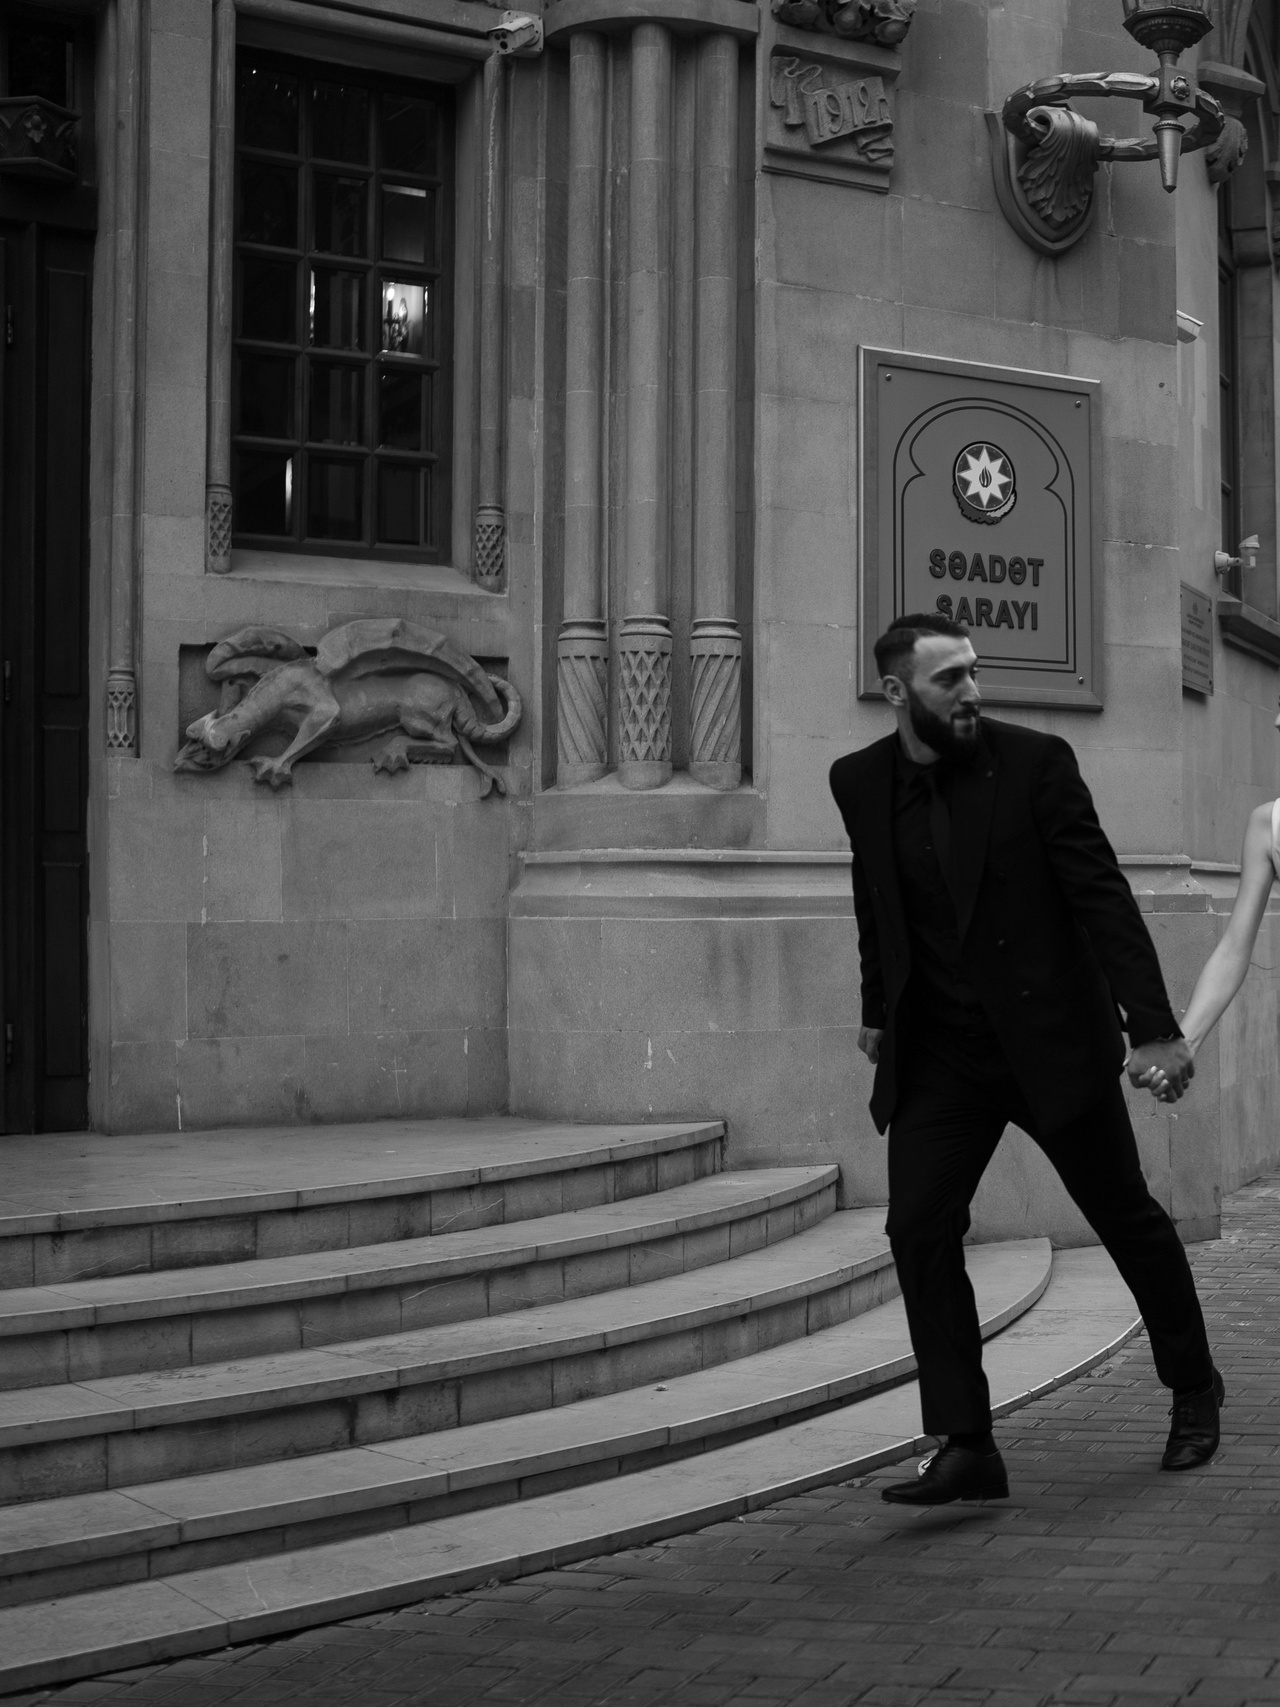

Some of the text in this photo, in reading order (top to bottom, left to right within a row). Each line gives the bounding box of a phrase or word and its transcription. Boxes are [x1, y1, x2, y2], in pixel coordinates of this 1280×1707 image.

[812, 82, 877, 137] 1912
[929, 548, 1045, 586] SƏADƏT
[936, 593, 1038, 630] SARAYI
